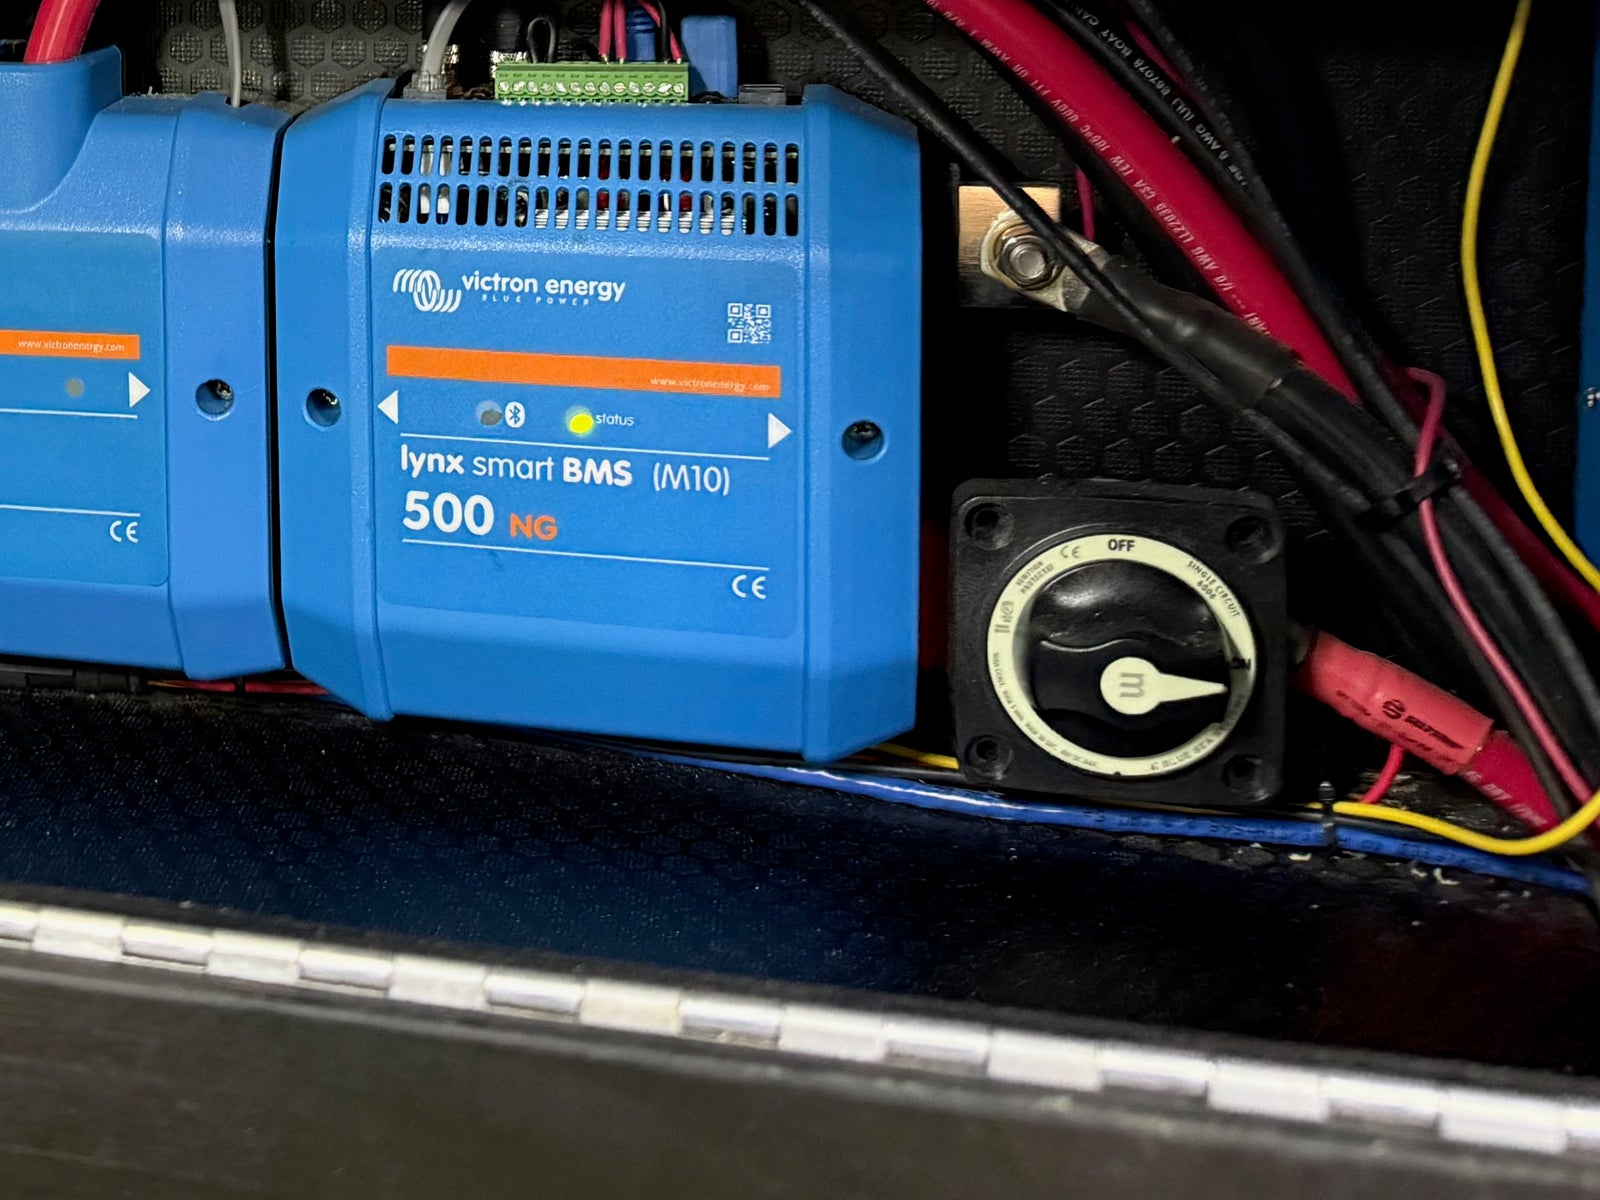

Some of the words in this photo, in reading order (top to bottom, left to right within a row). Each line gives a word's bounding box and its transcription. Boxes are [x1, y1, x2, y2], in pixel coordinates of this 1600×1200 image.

[1101, 28, 1132, 58] BOAT
[1133, 178, 1156, 201] CSA
[461, 270, 538, 293] victron
[545, 278, 626, 303] energy
[482, 294, 522, 303] BLUE
[536, 296, 590, 306] POWER
[18, 337, 125, 354] www.victronenergy.com
[649, 376, 771, 394] www.victronenergy.com
[595, 412, 635, 427] status
[400, 443, 465, 479] lynx
[472, 455, 555, 482] smart
[562, 456, 633, 487] BMS
[653, 462, 730, 496] (M10)
[402, 489, 495, 536] 500
[509, 512, 558, 541] NG
[1107, 538, 1136, 551] OFF
[1187, 560, 1218, 586] SINGLE
[1215, 585, 1241, 617] CIRCUIT
